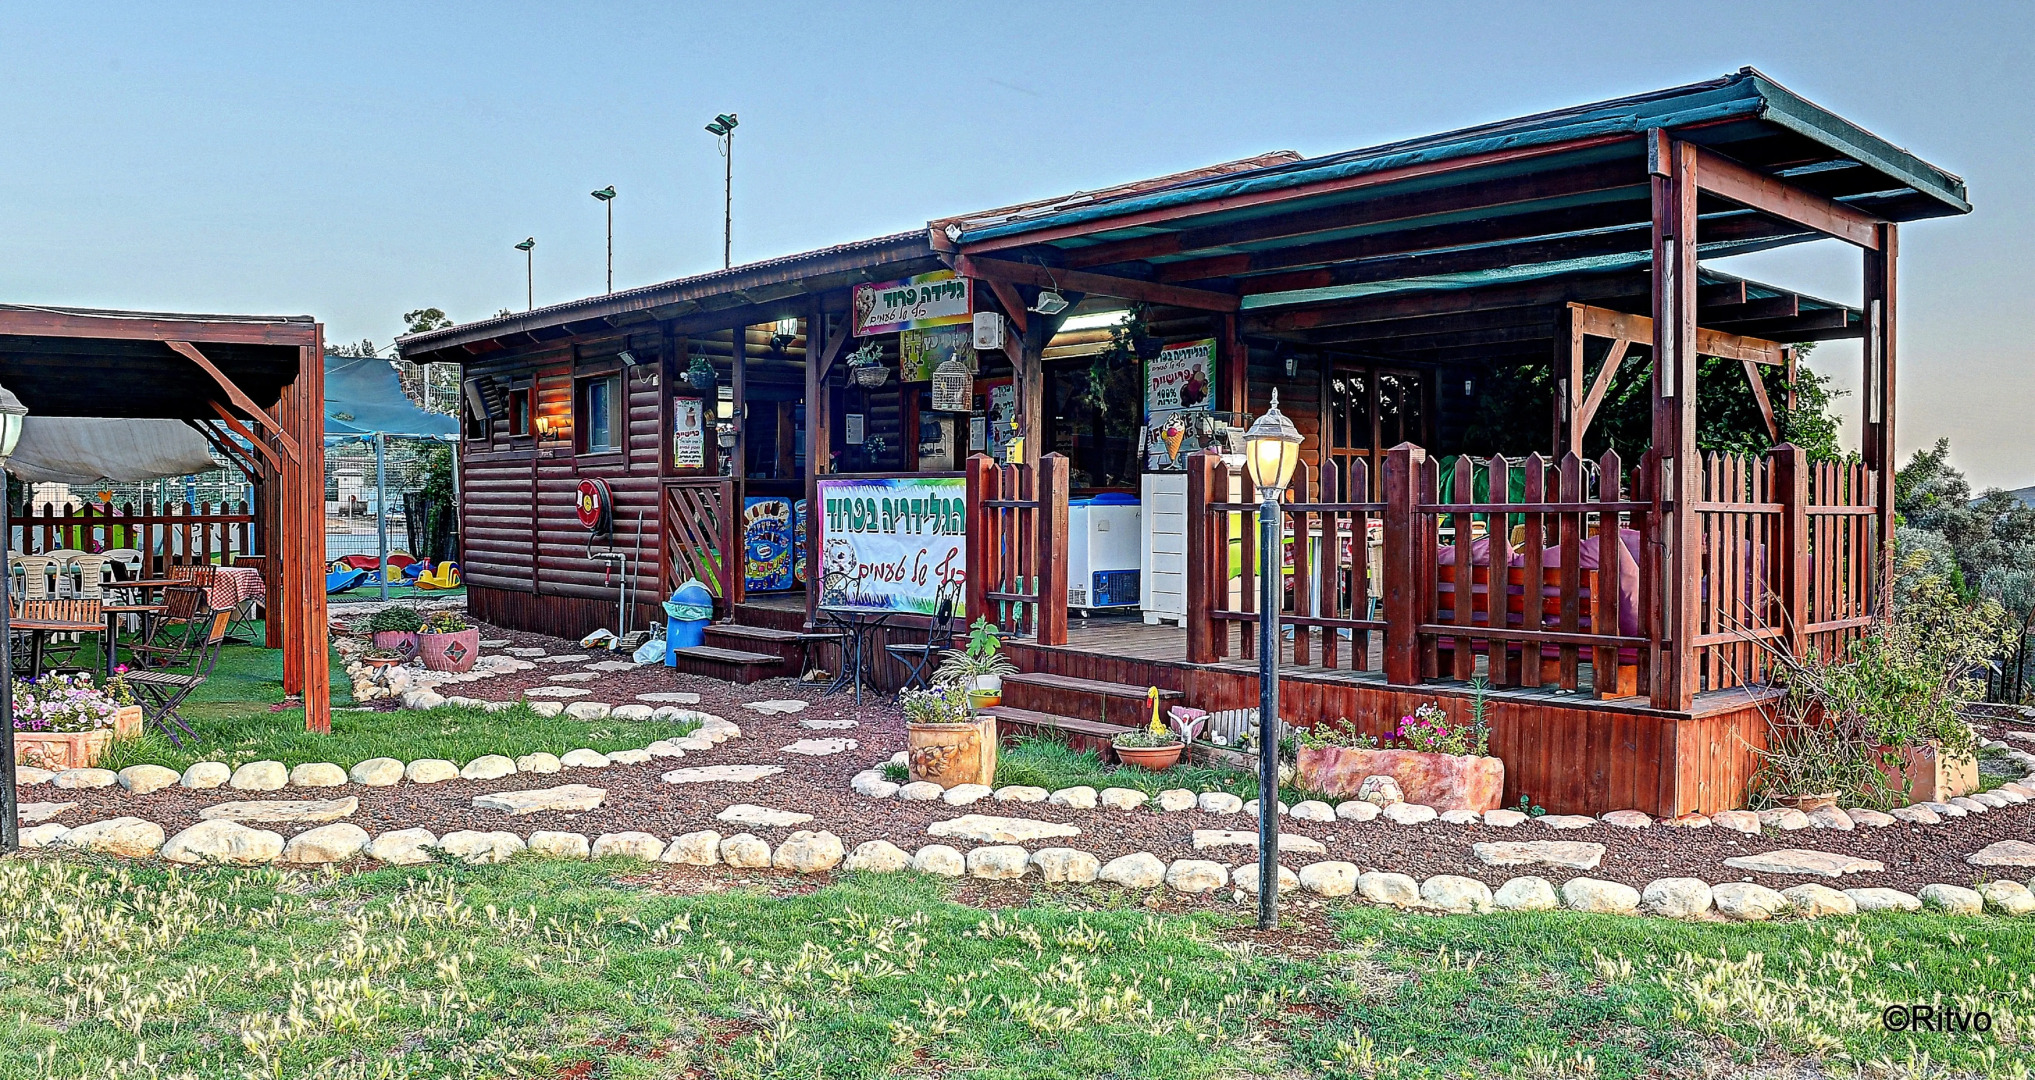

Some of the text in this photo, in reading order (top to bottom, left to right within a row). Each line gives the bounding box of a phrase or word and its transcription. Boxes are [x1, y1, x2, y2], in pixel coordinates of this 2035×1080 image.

[883, 280, 965, 309] גלידה פרוד
[870, 300, 927, 323] כיף של טעמים
[1157, 387, 1177, 399] 100%
[827, 492, 966, 536] הגלידריה בפרוד
[858, 547, 966, 586] כיף של טעמים
